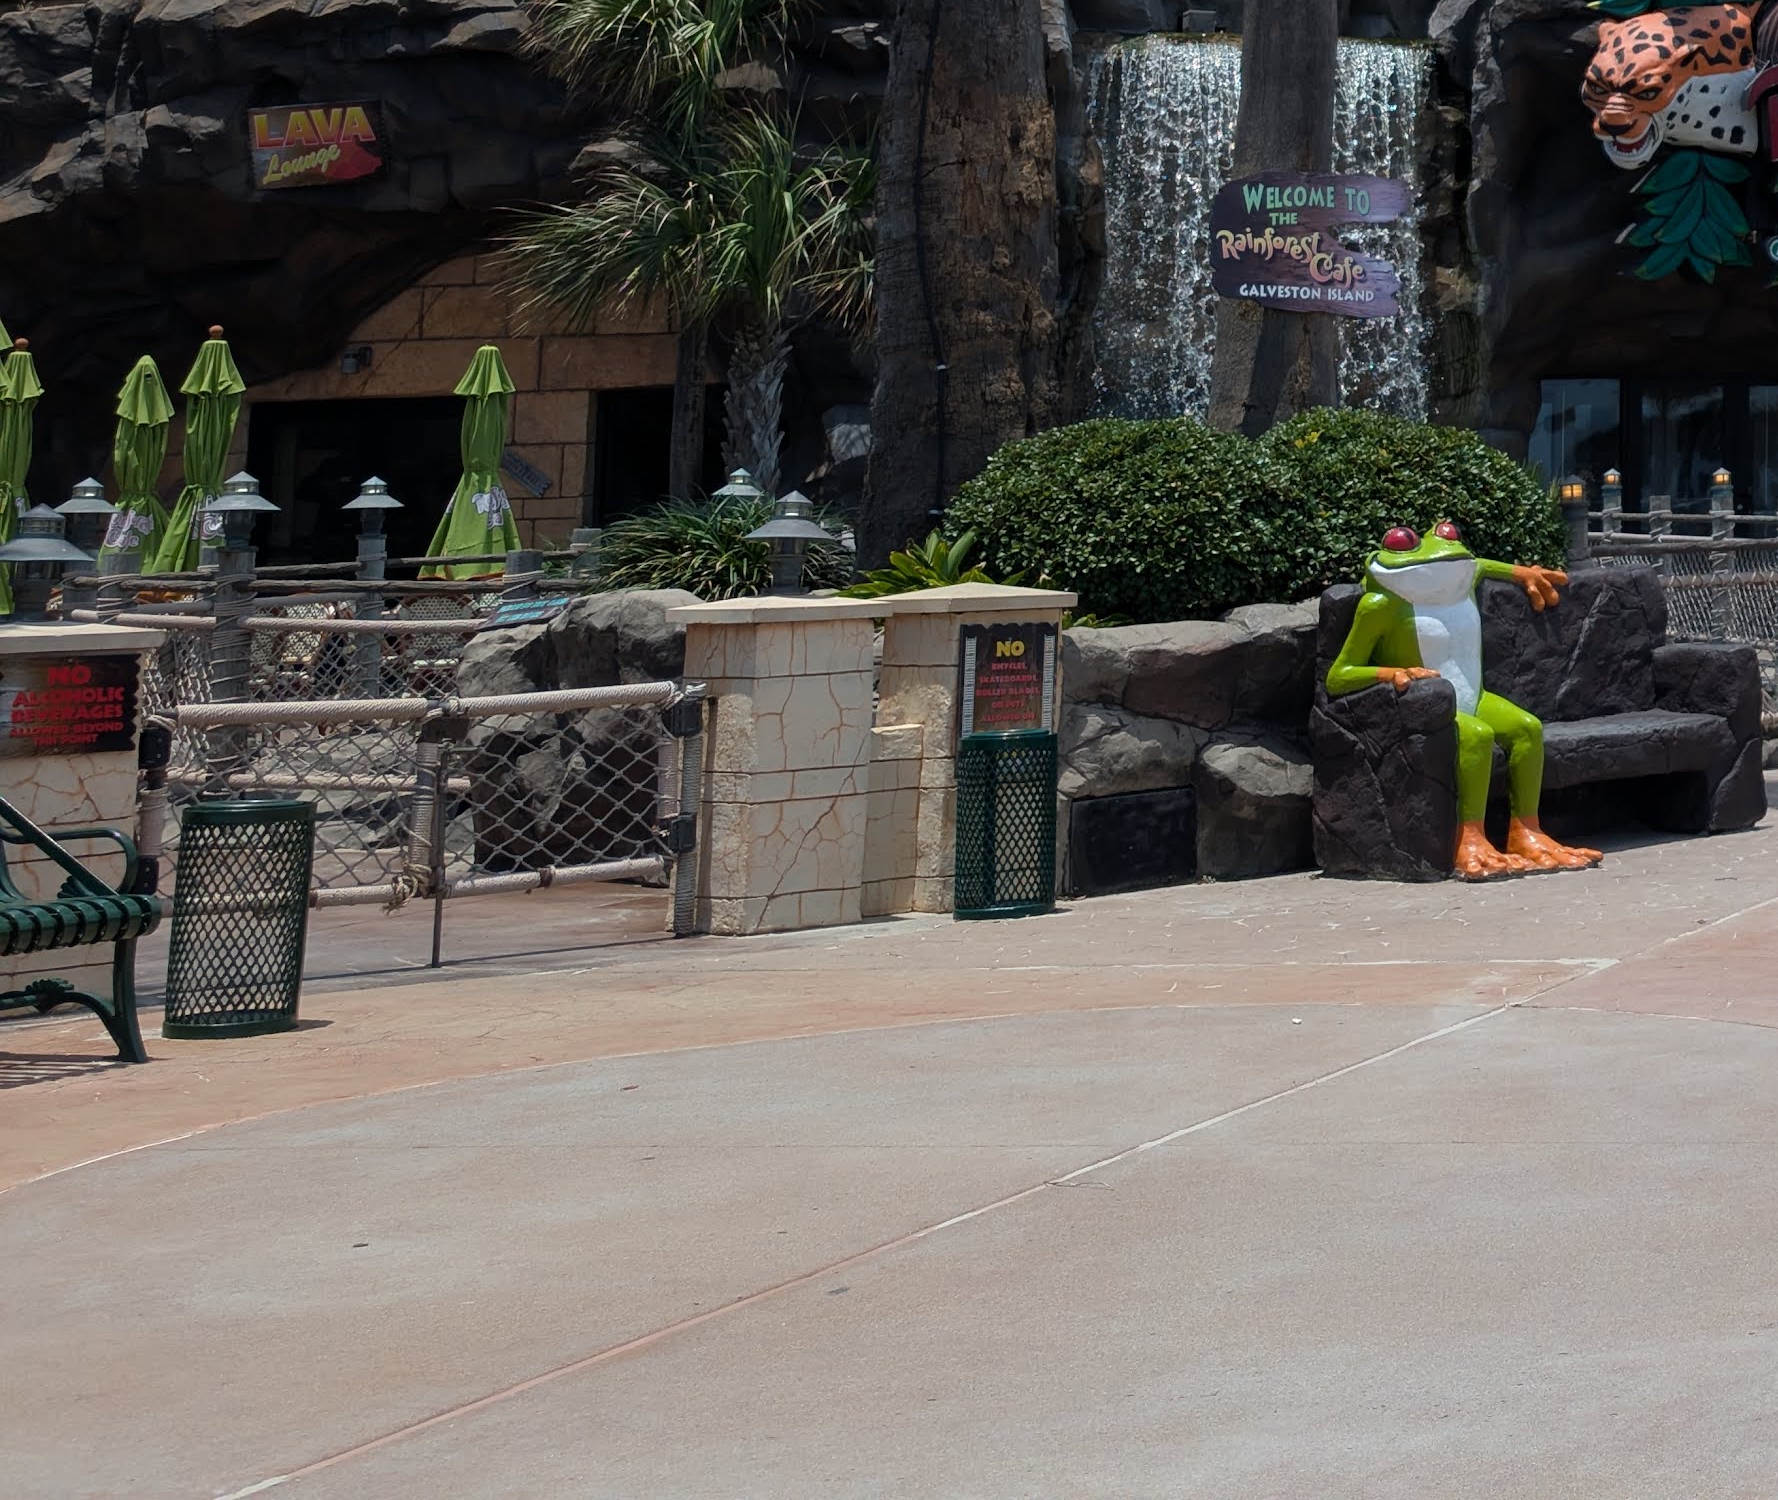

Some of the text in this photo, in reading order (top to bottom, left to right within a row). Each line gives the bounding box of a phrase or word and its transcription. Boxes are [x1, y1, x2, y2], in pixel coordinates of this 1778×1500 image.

[254, 106, 376, 149] LAVA
[262, 144, 341, 185] Lounge
[1243, 183, 1370, 215] WELCOME TO
[1269, 212, 1298, 226] THE
[1216, 227, 1320, 264] Rainforest
[1309, 251, 1365, 288] Cafe
[1240, 283, 1375, 302] GALVESTON ISLAND
[996, 641, 1025, 657] NO
[48, 665, 91, 685] NO
[12, 687, 125, 707] ALCOHOLIC
[10, 704, 123, 723] BEVERAGES
[73, 722, 124, 733] BEYOND
